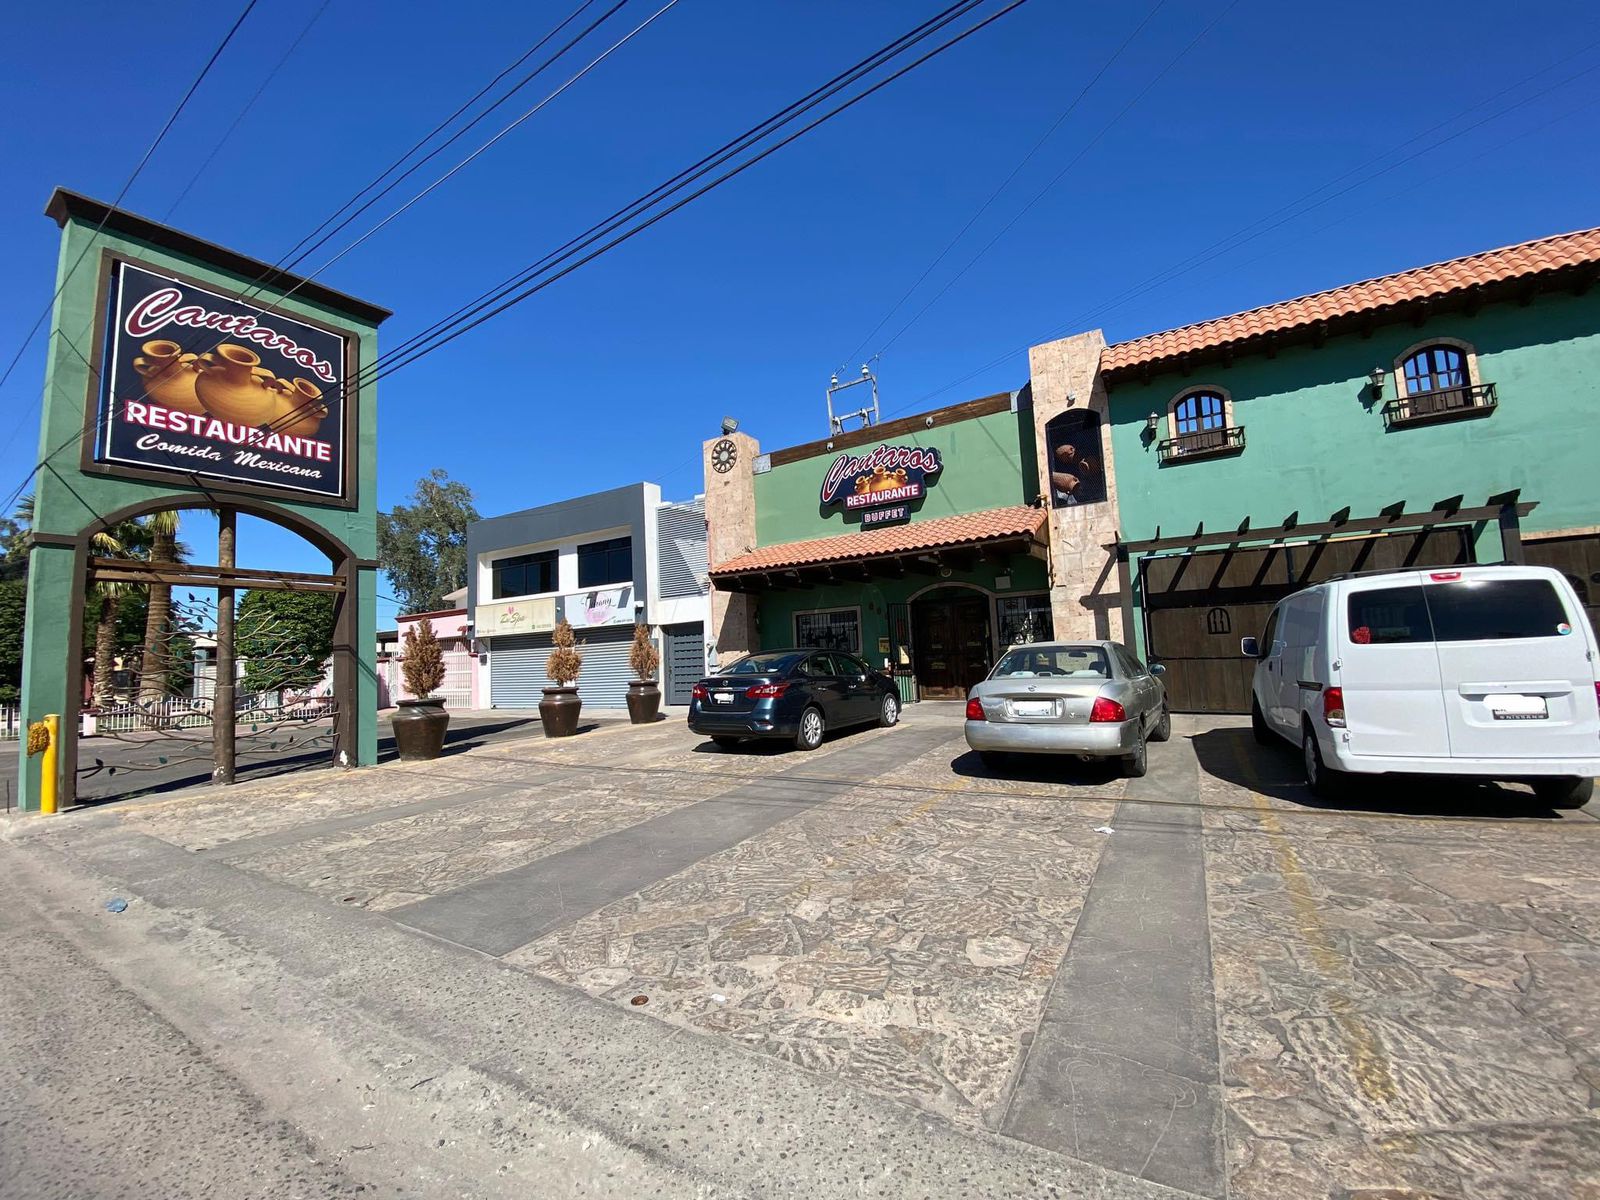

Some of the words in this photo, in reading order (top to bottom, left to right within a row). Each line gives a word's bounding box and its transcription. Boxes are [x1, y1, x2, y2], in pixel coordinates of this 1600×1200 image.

[125, 287, 337, 383] Cantaros
[123, 399, 332, 462] RESTAURANTE
[136, 433, 224, 462] Comida
[234, 450, 323, 479] Mexicana
[822, 444, 938, 503] Cantaros
[846, 484, 920, 508] RESTAURANTE
[864, 507, 905, 523] BUFFET
